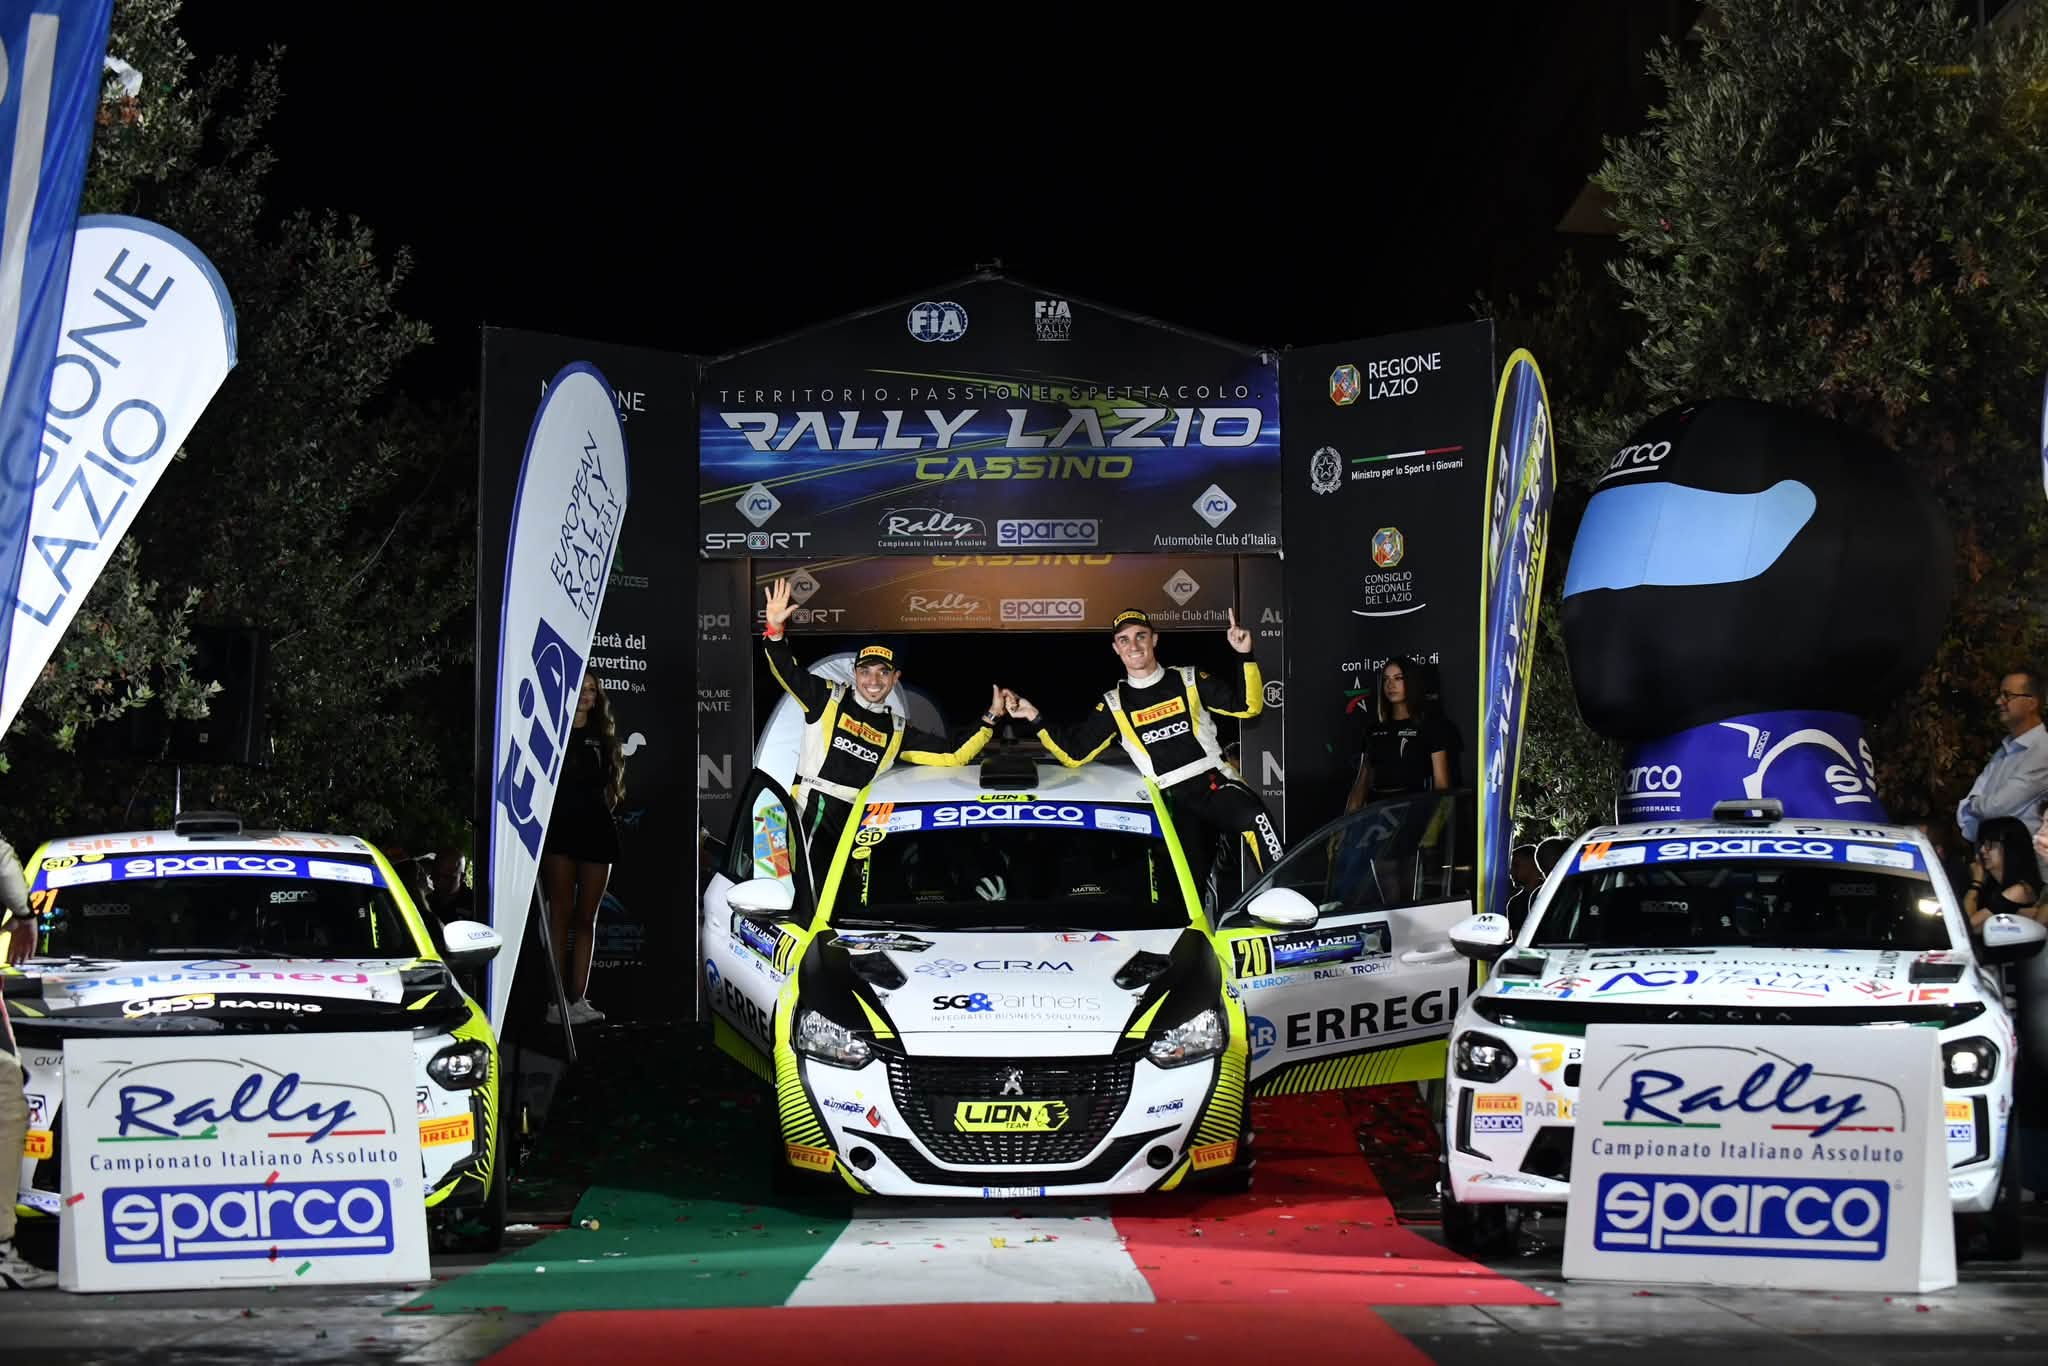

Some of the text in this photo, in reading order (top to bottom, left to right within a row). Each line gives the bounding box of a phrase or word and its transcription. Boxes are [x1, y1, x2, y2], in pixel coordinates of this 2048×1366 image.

[1036, 324, 1071, 332] RALLY
[1368, 352, 1442, 380] REGIONE
[1368, 377, 1419, 401] LAZIO
[720, 407, 1262, 450] RALLY LAZIO
[915, 456, 1133, 480] CASSINO
[1351, 466, 1381, 481] Ministro
[1381, 467, 1395, 479] per
[1396, 465, 1403, 476] lo
[1404, 463, 1425, 476] Sport
[1436, 458, 1464, 471] Giovani
[15, 398, 166, 626] LAZIO
[550, 429, 598, 586] EUROPEAN
[562, 454, 609, 607] RALLY
[888, 513, 973, 539] Rally
[1000, 521, 1096, 544] sparco
[705, 532, 811, 550] SPORT
[878, 538, 986, 549] Campionato Italiano Assoluto
[1153, 534, 1213, 547] Automobile
[1215, 534, 1239, 546] Club
[577, 487, 620, 620] TROPHY
[1364, 570, 1413, 585] CONSIGLIO
[1364, 581, 1413, 596] REGIONALE
[1365, 591, 1413, 606] DEL LAZIO
[909, 594, 981, 613] Rally
[1003, 600, 1082, 618] sparco
[1182, 609, 1202, 621] Club
[625, 634, 647, 650] del
[588, 655, 647, 671] avertino
[1341, 660, 1362, 672] con
[1364, 659, 1371, 671] il
[1428, 652, 1439, 665] di
[631, 682, 646, 693] SpA
[698, 700, 731, 712] INATE
[1136, 701, 1180, 724] PIRELLI
[1142, 720, 1191, 745] sparco
[833, 736, 879, 765] sparco
[1753, 730, 1771, 760] sparco
[980, 794, 1019, 802] LION
[861, 803, 895, 826] 20
[933, 803, 1085, 828] sparco
[858, 831, 882, 844] SD
[1657, 838, 1834, 860] sparco
[46, 858, 73, 869] SD
[124, 857, 297, 878] sparco
[1274, 939, 1316, 953] RALLY
[1318, 934, 1357, 947] LAZIO
[974, 960, 1074, 971] CRM
[1237, 938, 1267, 978] 20
[1313, 968, 1346, 981] RALLY
[1350, 962, 1392, 976] TROPHY
[1596, 969, 1699, 992] ACI
[219, 1000, 323, 1013] RACING
[1286, 986, 1460, 1049] ERREGI
[115, 1072, 357, 1144] Rally
[1477, 1094, 1519, 1110] PIRELLI
[1623, 1062, 1867, 1138] Rally
[964, 1105, 1032, 1124] LION
[1475, 1116, 1521, 1131] sparco
[90, 1147, 399, 1173] Campionato Italiano Assoluto
[1592, 1138, 1905, 1164] Campionato Italiano Assoluto
[111, 1187, 387, 1259] sparco
[1600, 1180, 1881, 1254] sparco
